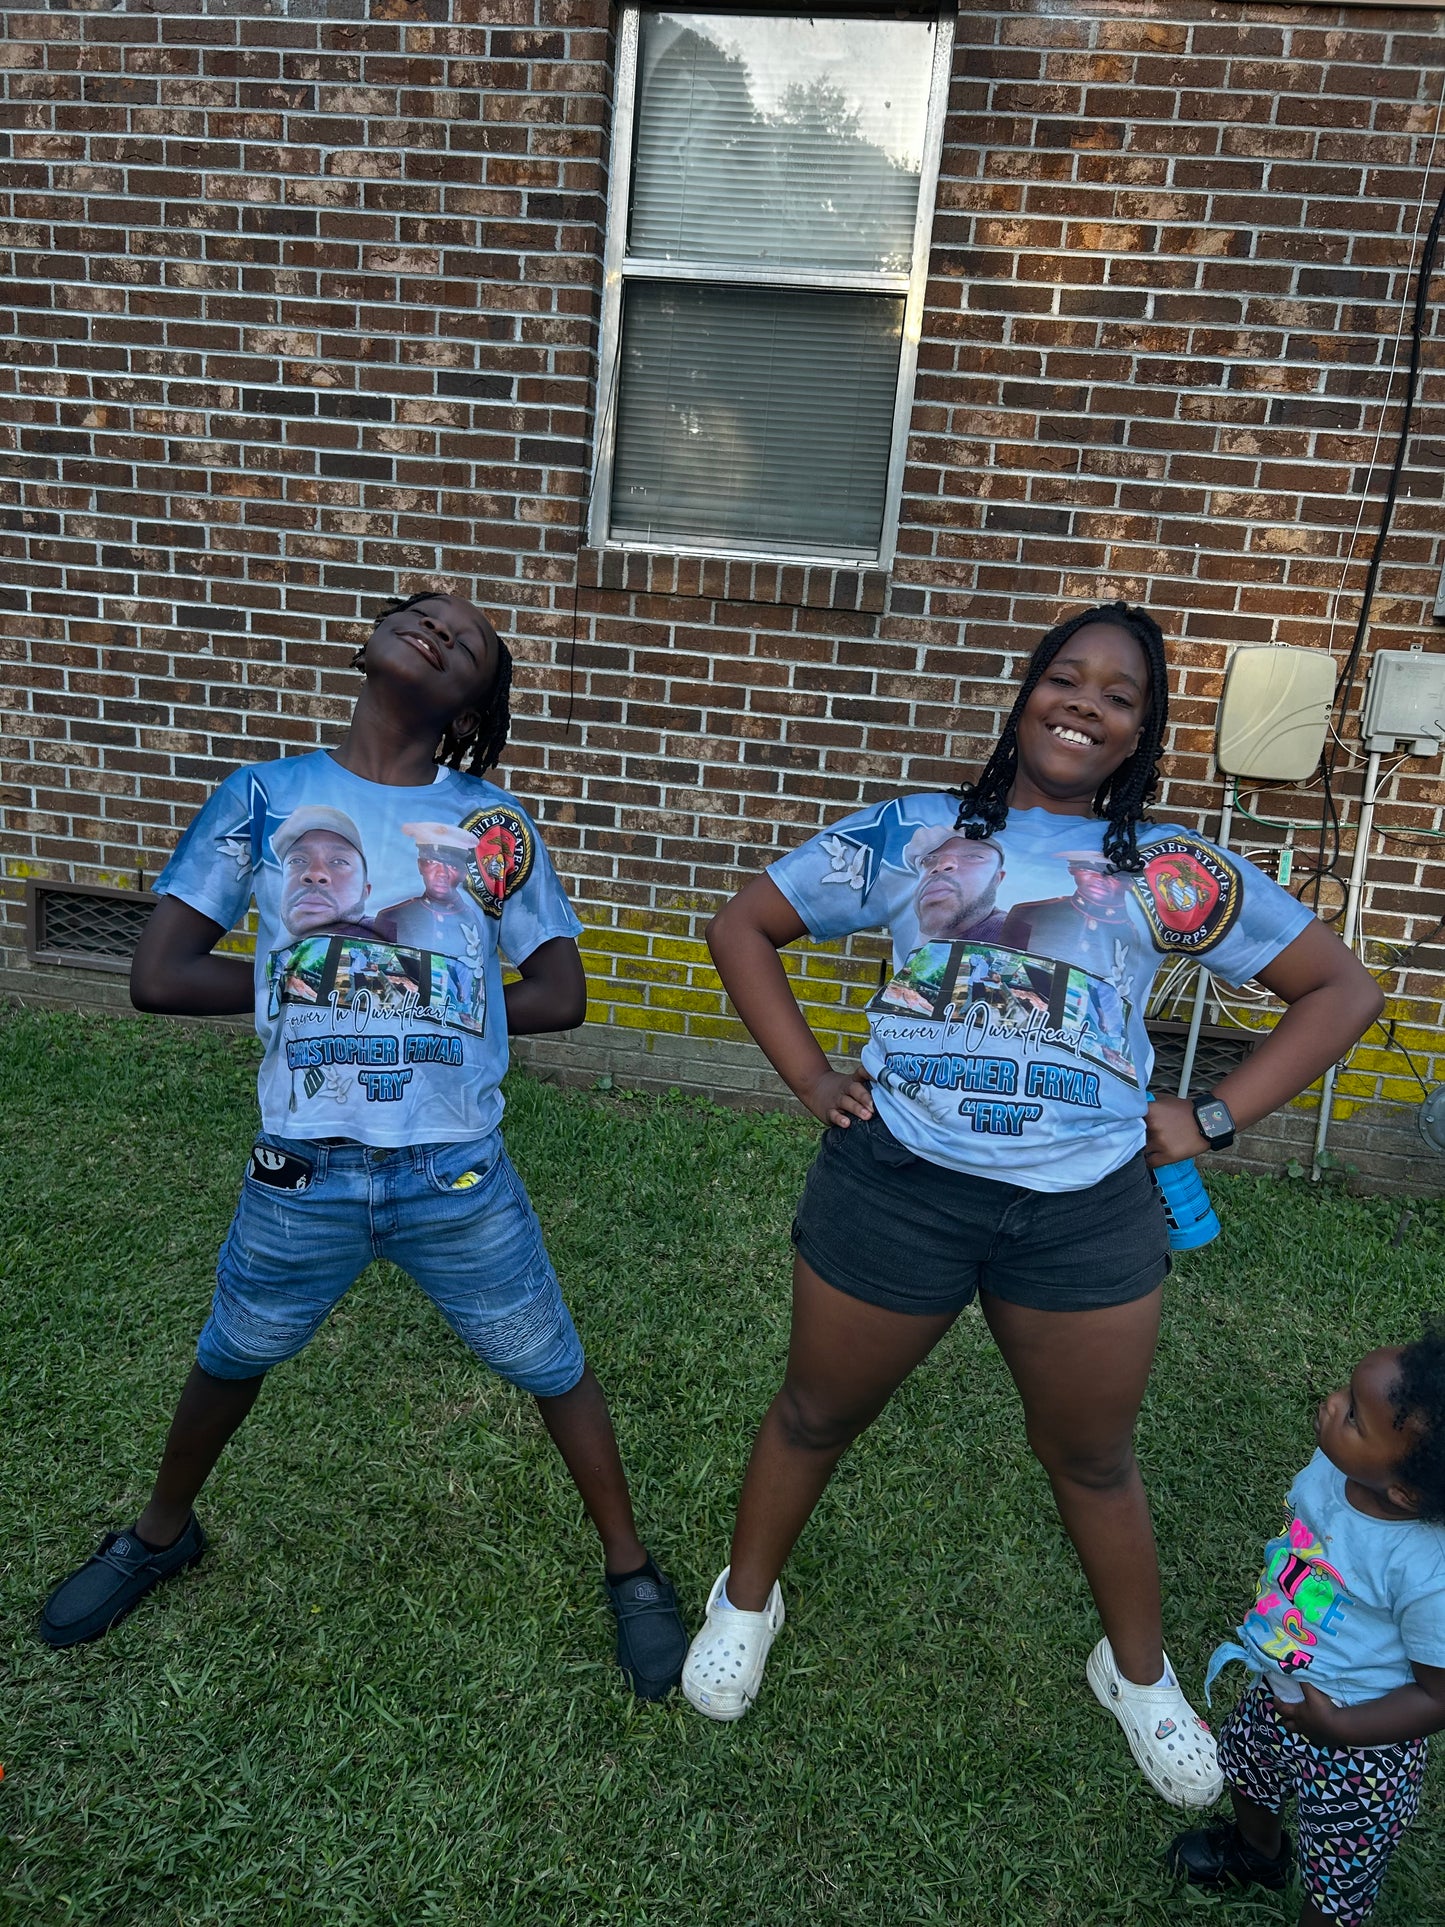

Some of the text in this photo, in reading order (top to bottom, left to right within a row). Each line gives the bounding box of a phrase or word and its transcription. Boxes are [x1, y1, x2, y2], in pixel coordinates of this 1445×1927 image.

[471, 813, 506, 839] NITED
[1138, 842, 1230, 902] UNITED STATES
[1133, 876, 1208, 945] MARINE CORPS
[328, 989, 349, 1031] In
[352, 988, 396, 1033] Our
[397, 990, 456, 1031] Heart
[870, 1000, 1098, 1058] Forever In Our Heart
[403, 1034, 464, 1065] FRYAR
[885, 1052, 1101, 1108] RISTOPHER FRYAR
